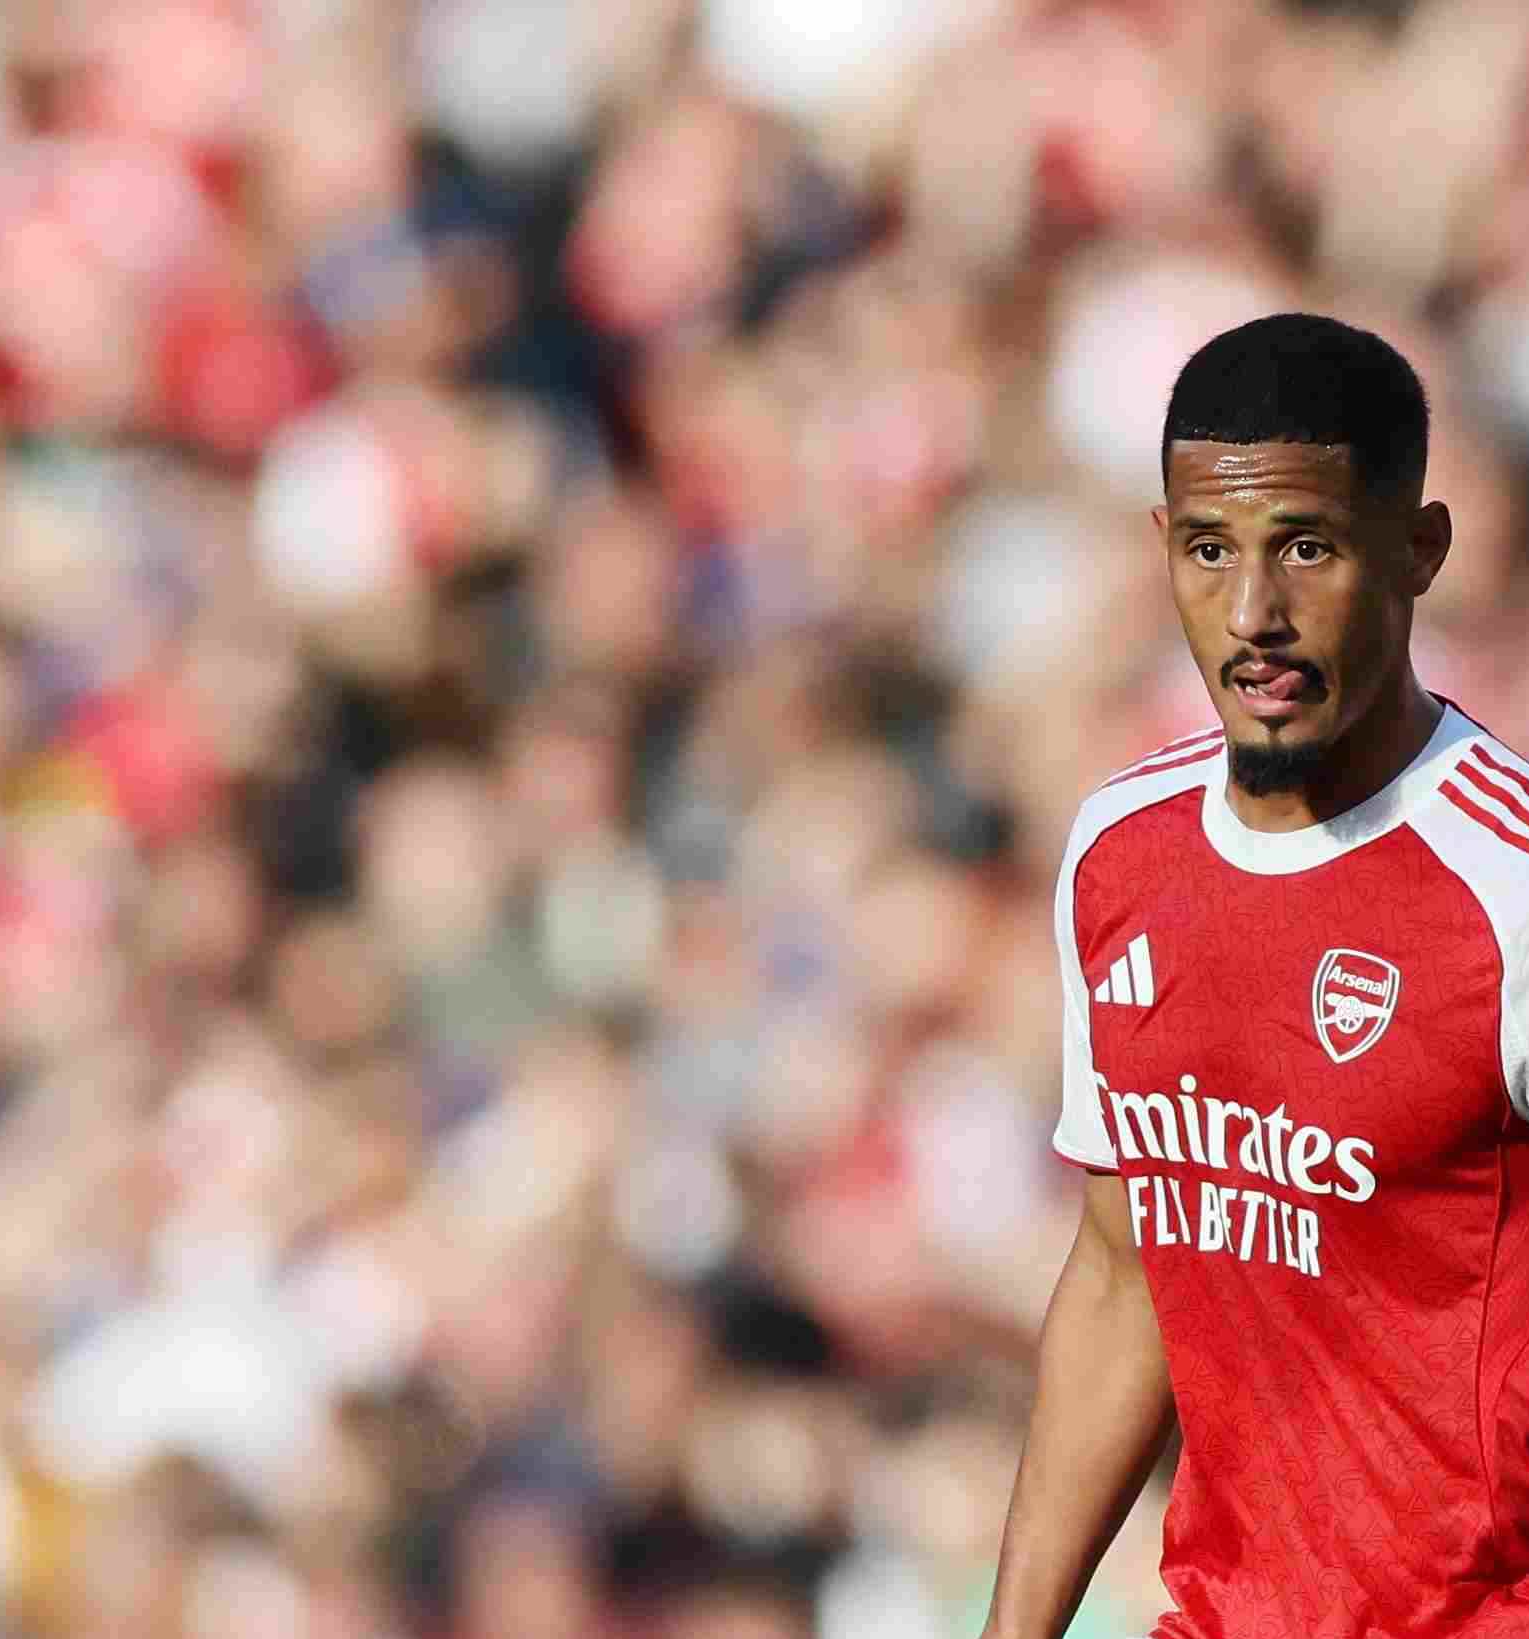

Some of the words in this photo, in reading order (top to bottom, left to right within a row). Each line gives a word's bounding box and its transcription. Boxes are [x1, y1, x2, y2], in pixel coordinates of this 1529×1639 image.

[1328, 965, 1388, 997] Arsenal
[1092, 1071, 1377, 1203] mirates
[1197, 1181, 1322, 1278] BETTER
